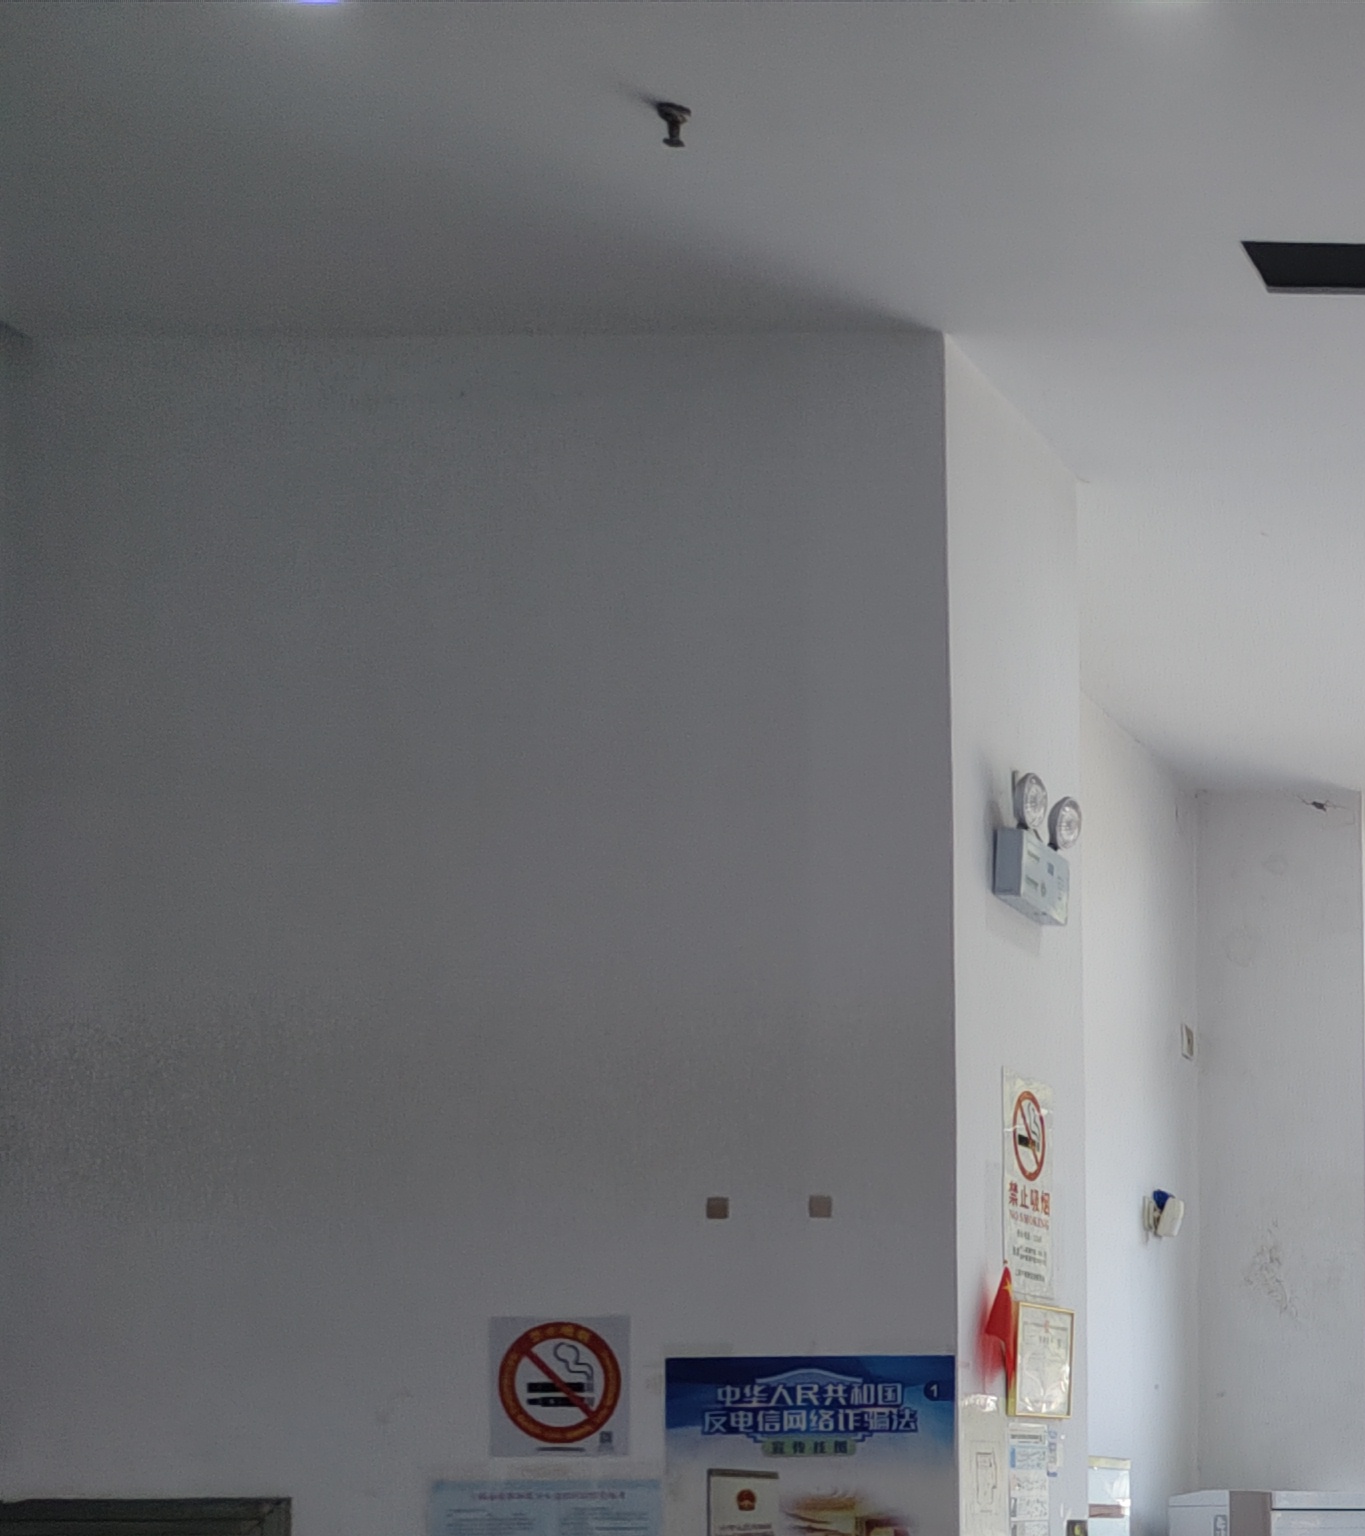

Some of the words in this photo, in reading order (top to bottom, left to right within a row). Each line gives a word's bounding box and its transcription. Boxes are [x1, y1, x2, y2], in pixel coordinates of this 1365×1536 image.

[1008, 1181, 1051, 1217] 禁止吸烟
[716, 1383, 903, 1407] 中华人民共和国
[929, 1384, 940, 1398] 1
[703, 1409, 920, 1433] 反电信网络诈骗法
